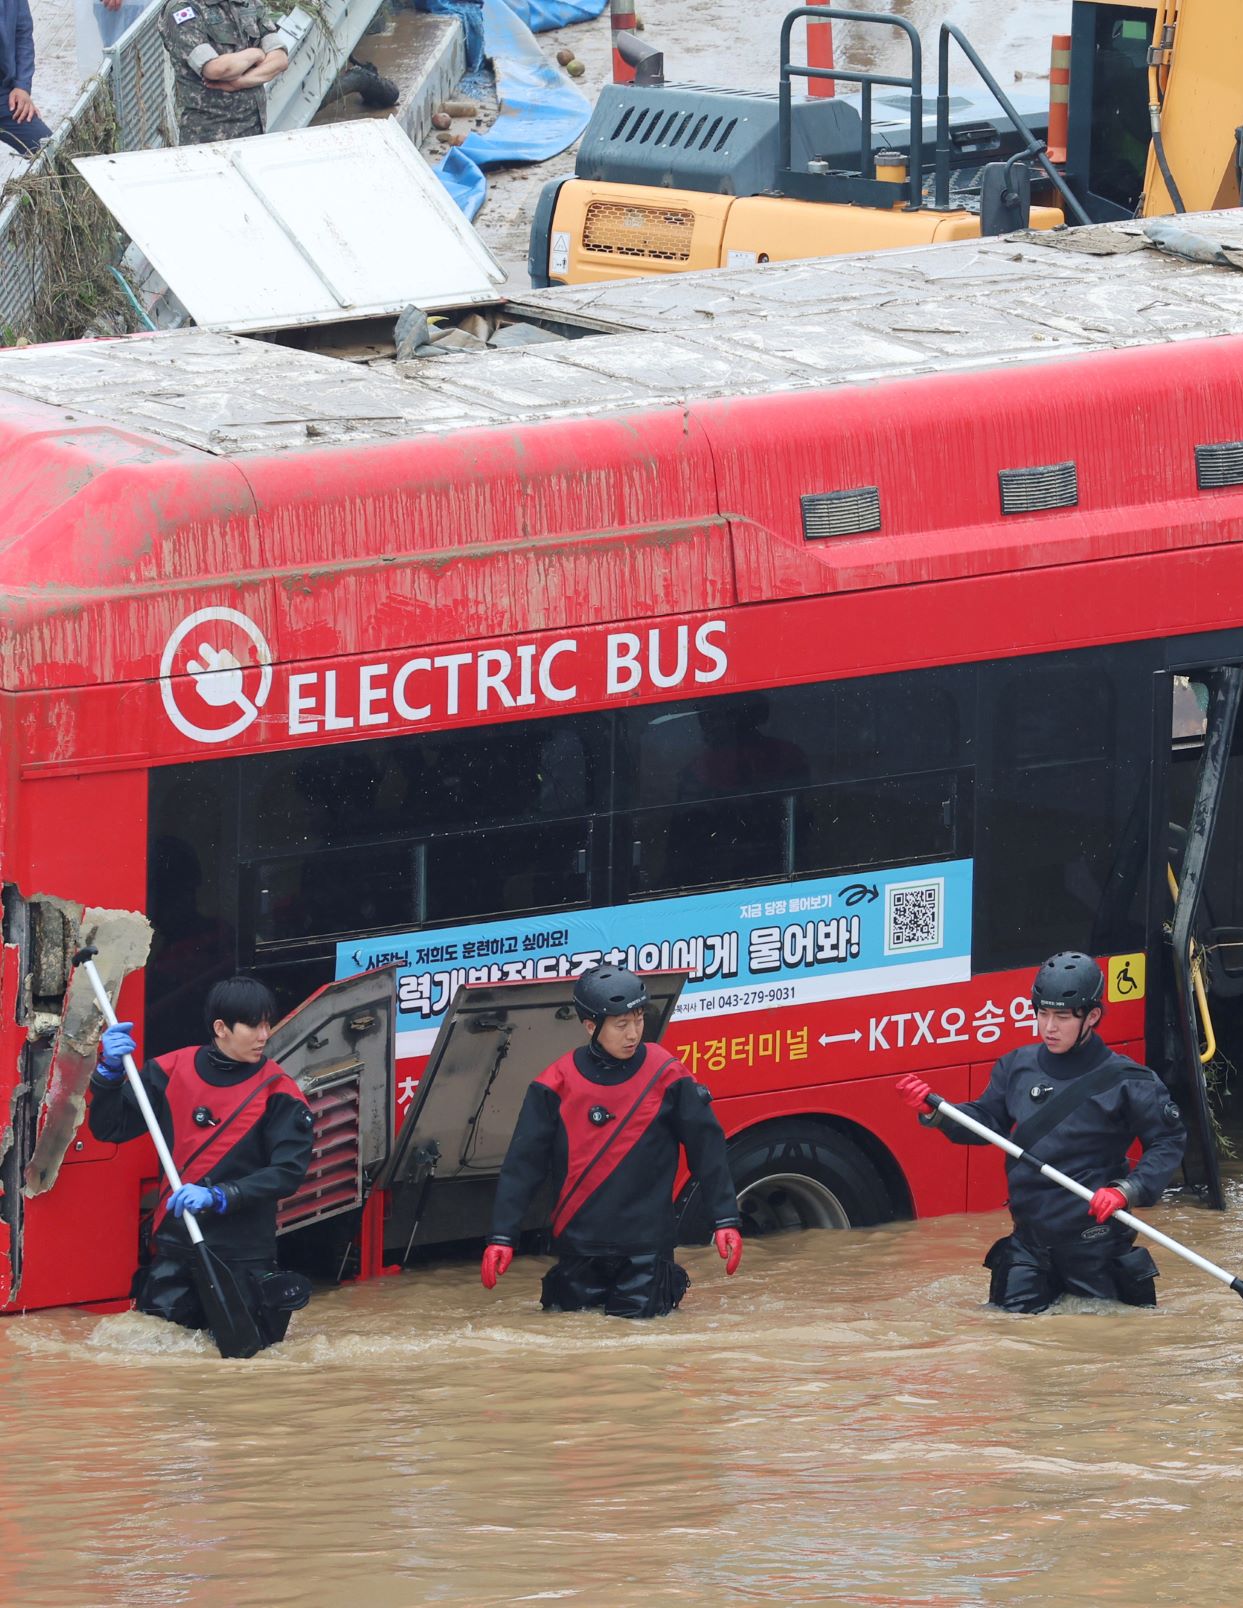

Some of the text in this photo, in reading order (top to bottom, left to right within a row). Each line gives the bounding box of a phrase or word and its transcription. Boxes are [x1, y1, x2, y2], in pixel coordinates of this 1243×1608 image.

[287, 620, 729, 736] ELECTRIC BUS
[740, 894, 832, 919] 지금 당장 물어보기
[416, 943, 458, 965] 저희도
[461, 936, 518, 960] 훈련하고
[521, 929, 569, 952] 싶어요!
[748, 914, 861, 974] 물어봐!
[699, 997, 716, 1012] Tel
[718, 987, 796, 1010] 043-279-9031
[676, 996, 1039, 1075] 가경터미널 KTX오송역
